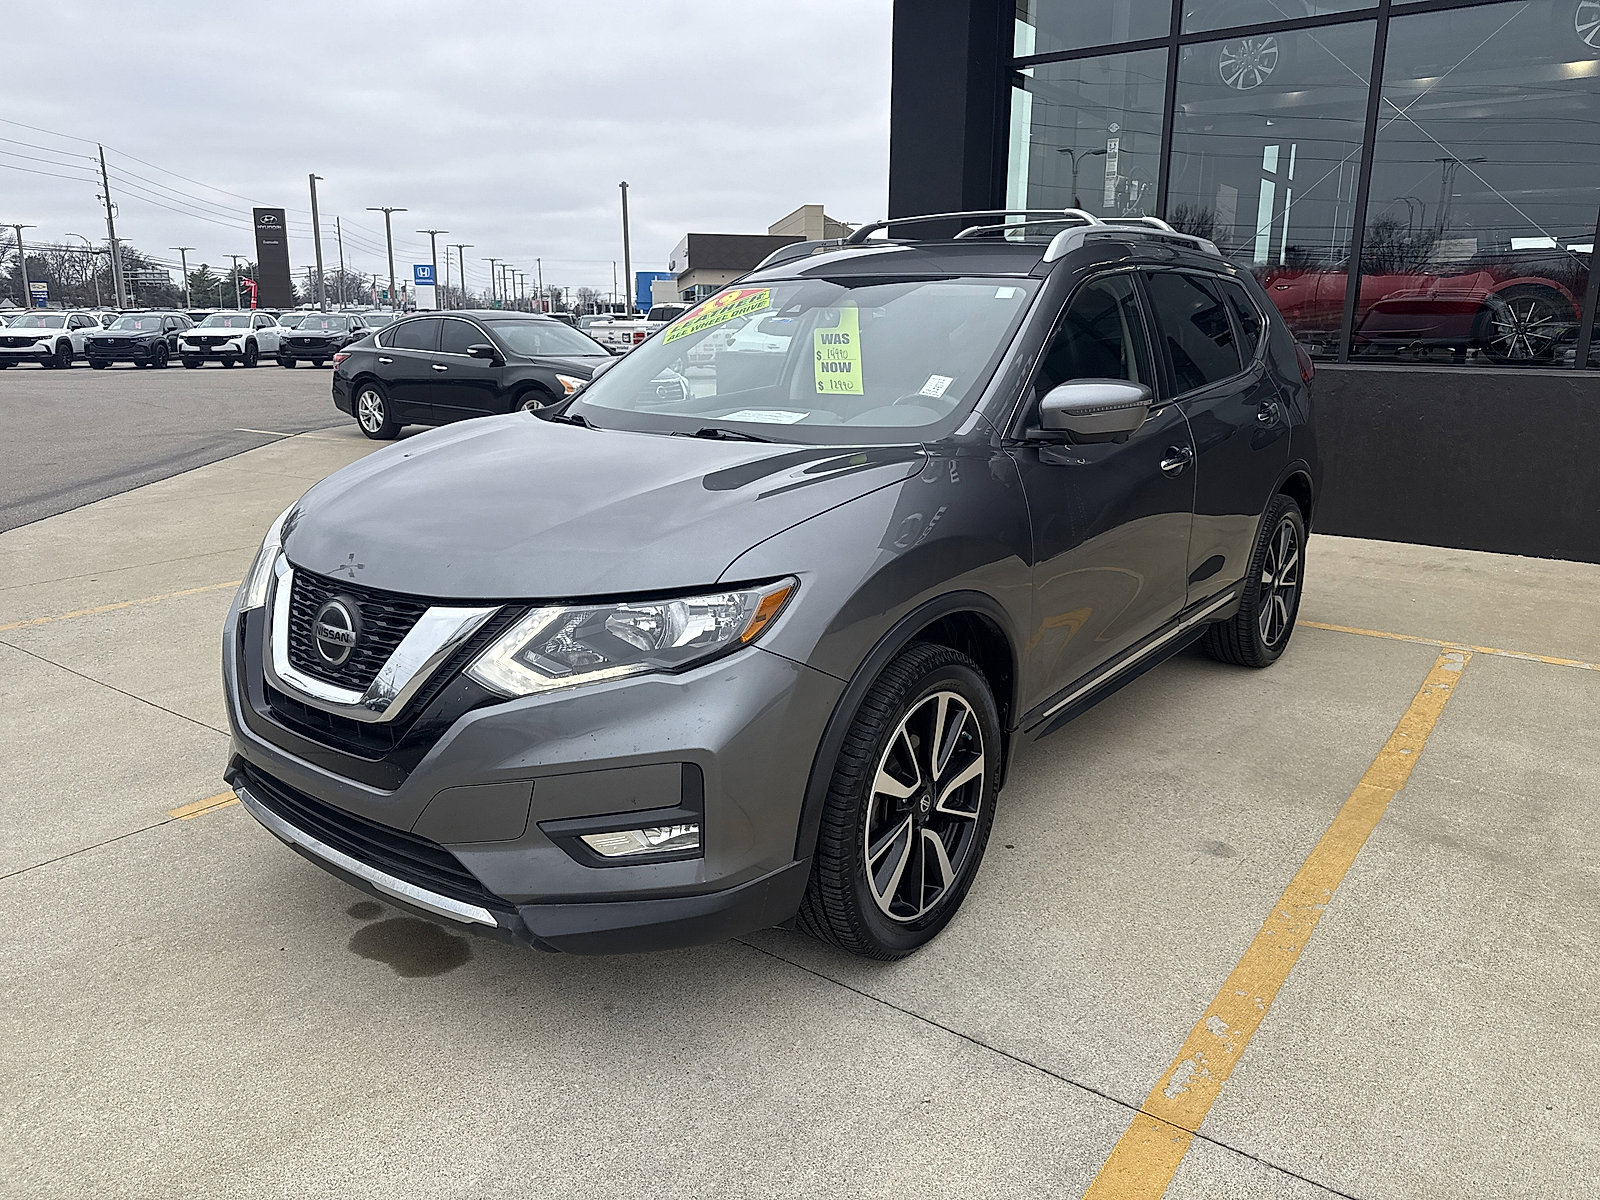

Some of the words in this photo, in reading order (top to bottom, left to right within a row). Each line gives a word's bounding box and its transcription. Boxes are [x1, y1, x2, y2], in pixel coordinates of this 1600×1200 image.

[666, 329, 688, 342] ALL
[691, 314, 729, 332] WHEEL
[730, 301, 766, 317] DRIVE
[820, 333, 850, 345] WAS
[816, 350, 822, 361] $
[821, 362, 852, 373] NOW
[817, 380, 824, 391] $
[316, 625, 349, 643] NISSAN
